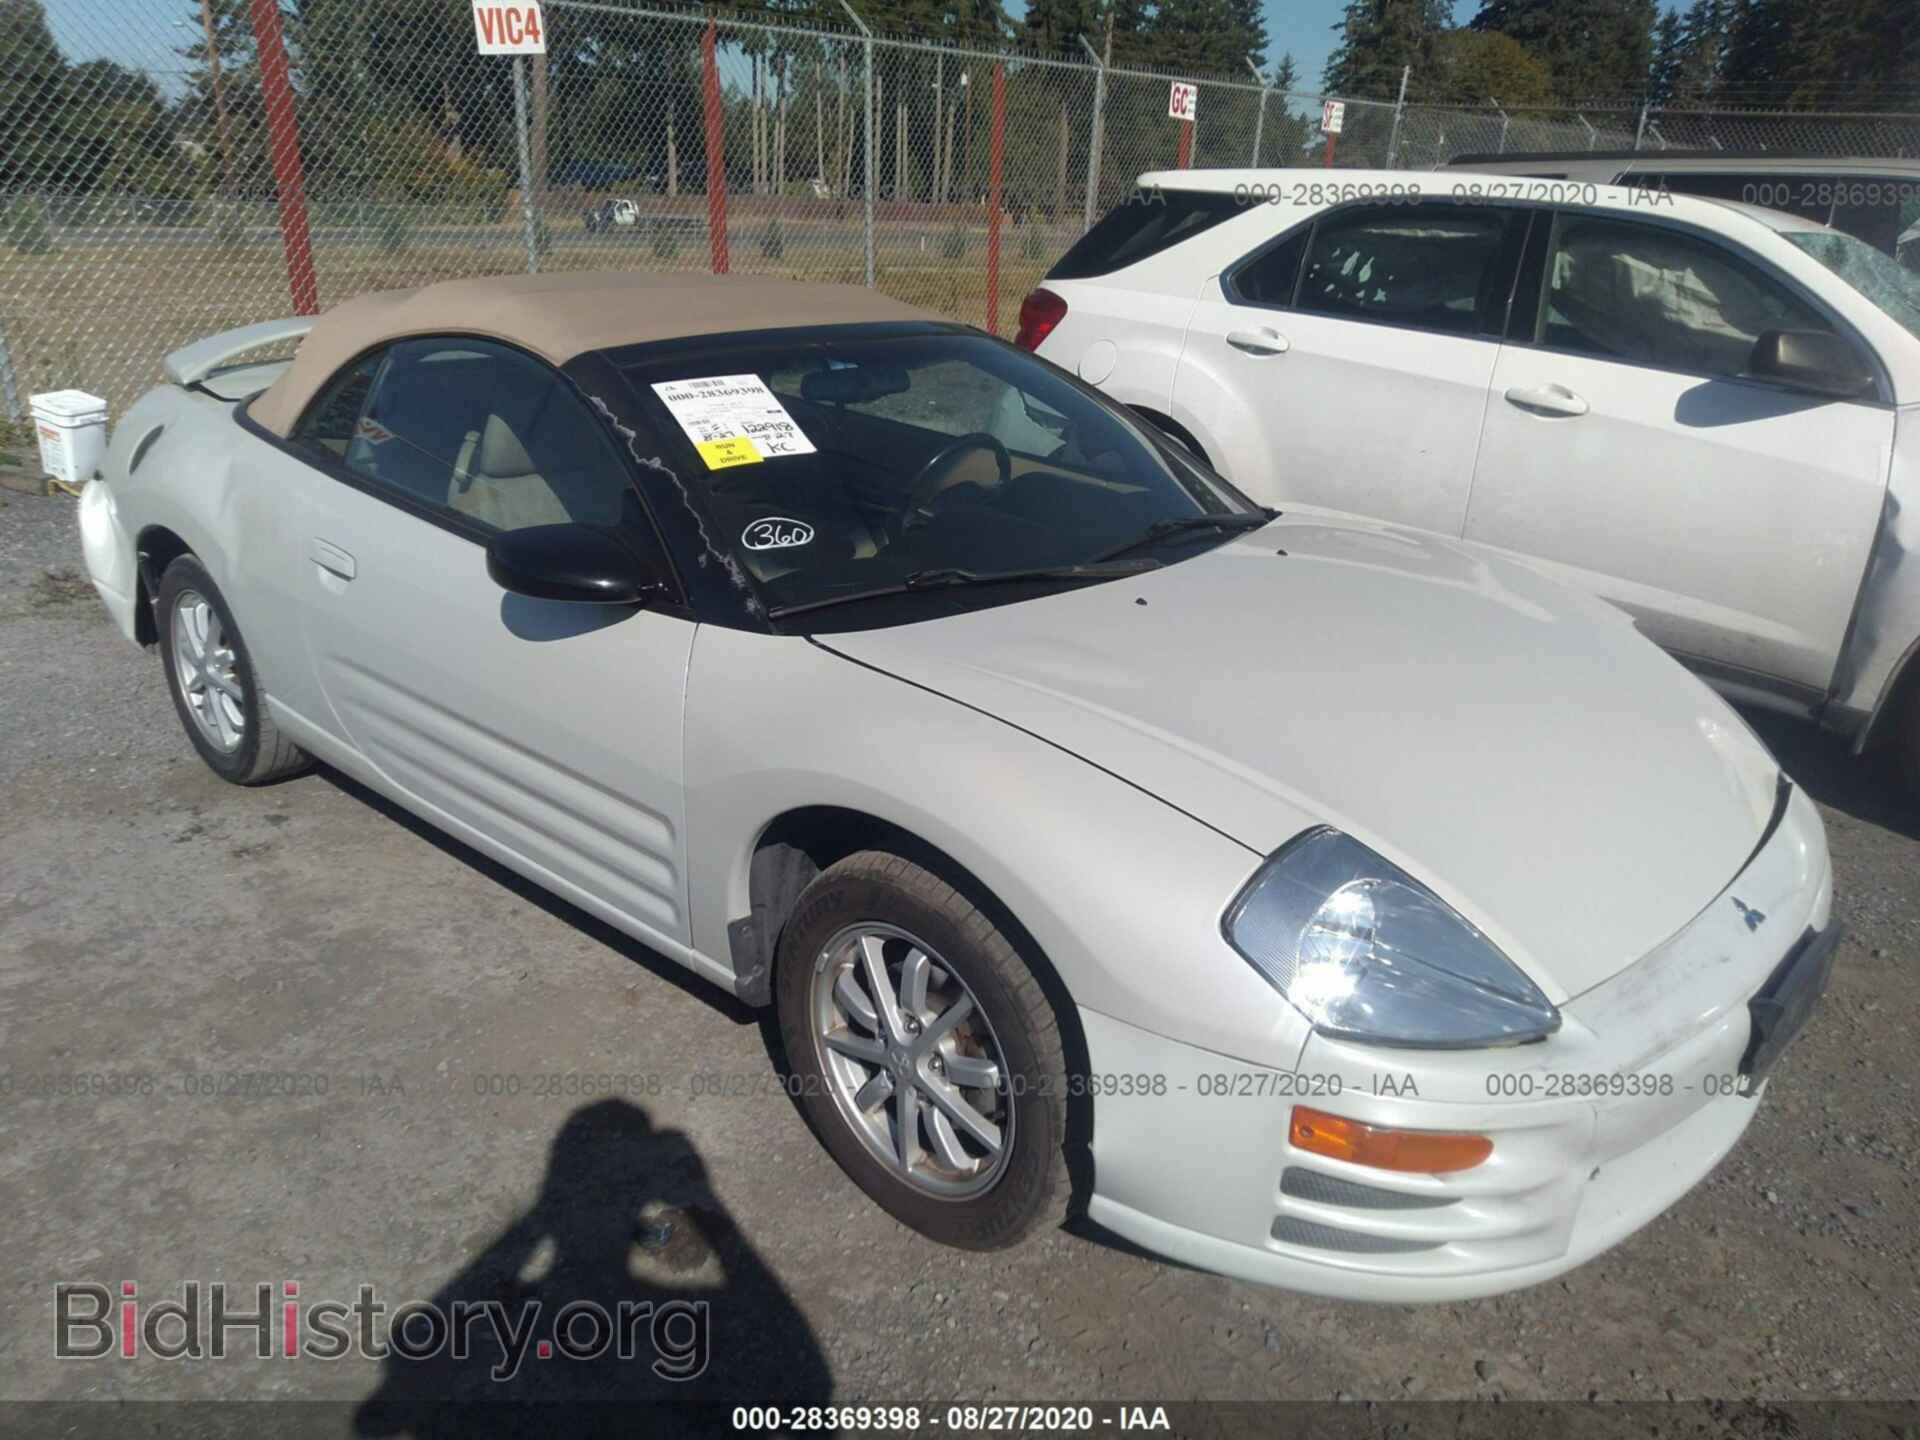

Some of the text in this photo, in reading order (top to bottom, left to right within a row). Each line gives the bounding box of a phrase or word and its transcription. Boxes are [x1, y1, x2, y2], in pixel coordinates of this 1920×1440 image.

[477, 8, 540, 44] VIC4
[1172, 86, 1189, 114] GC
[753, 524, 807, 547] 360
